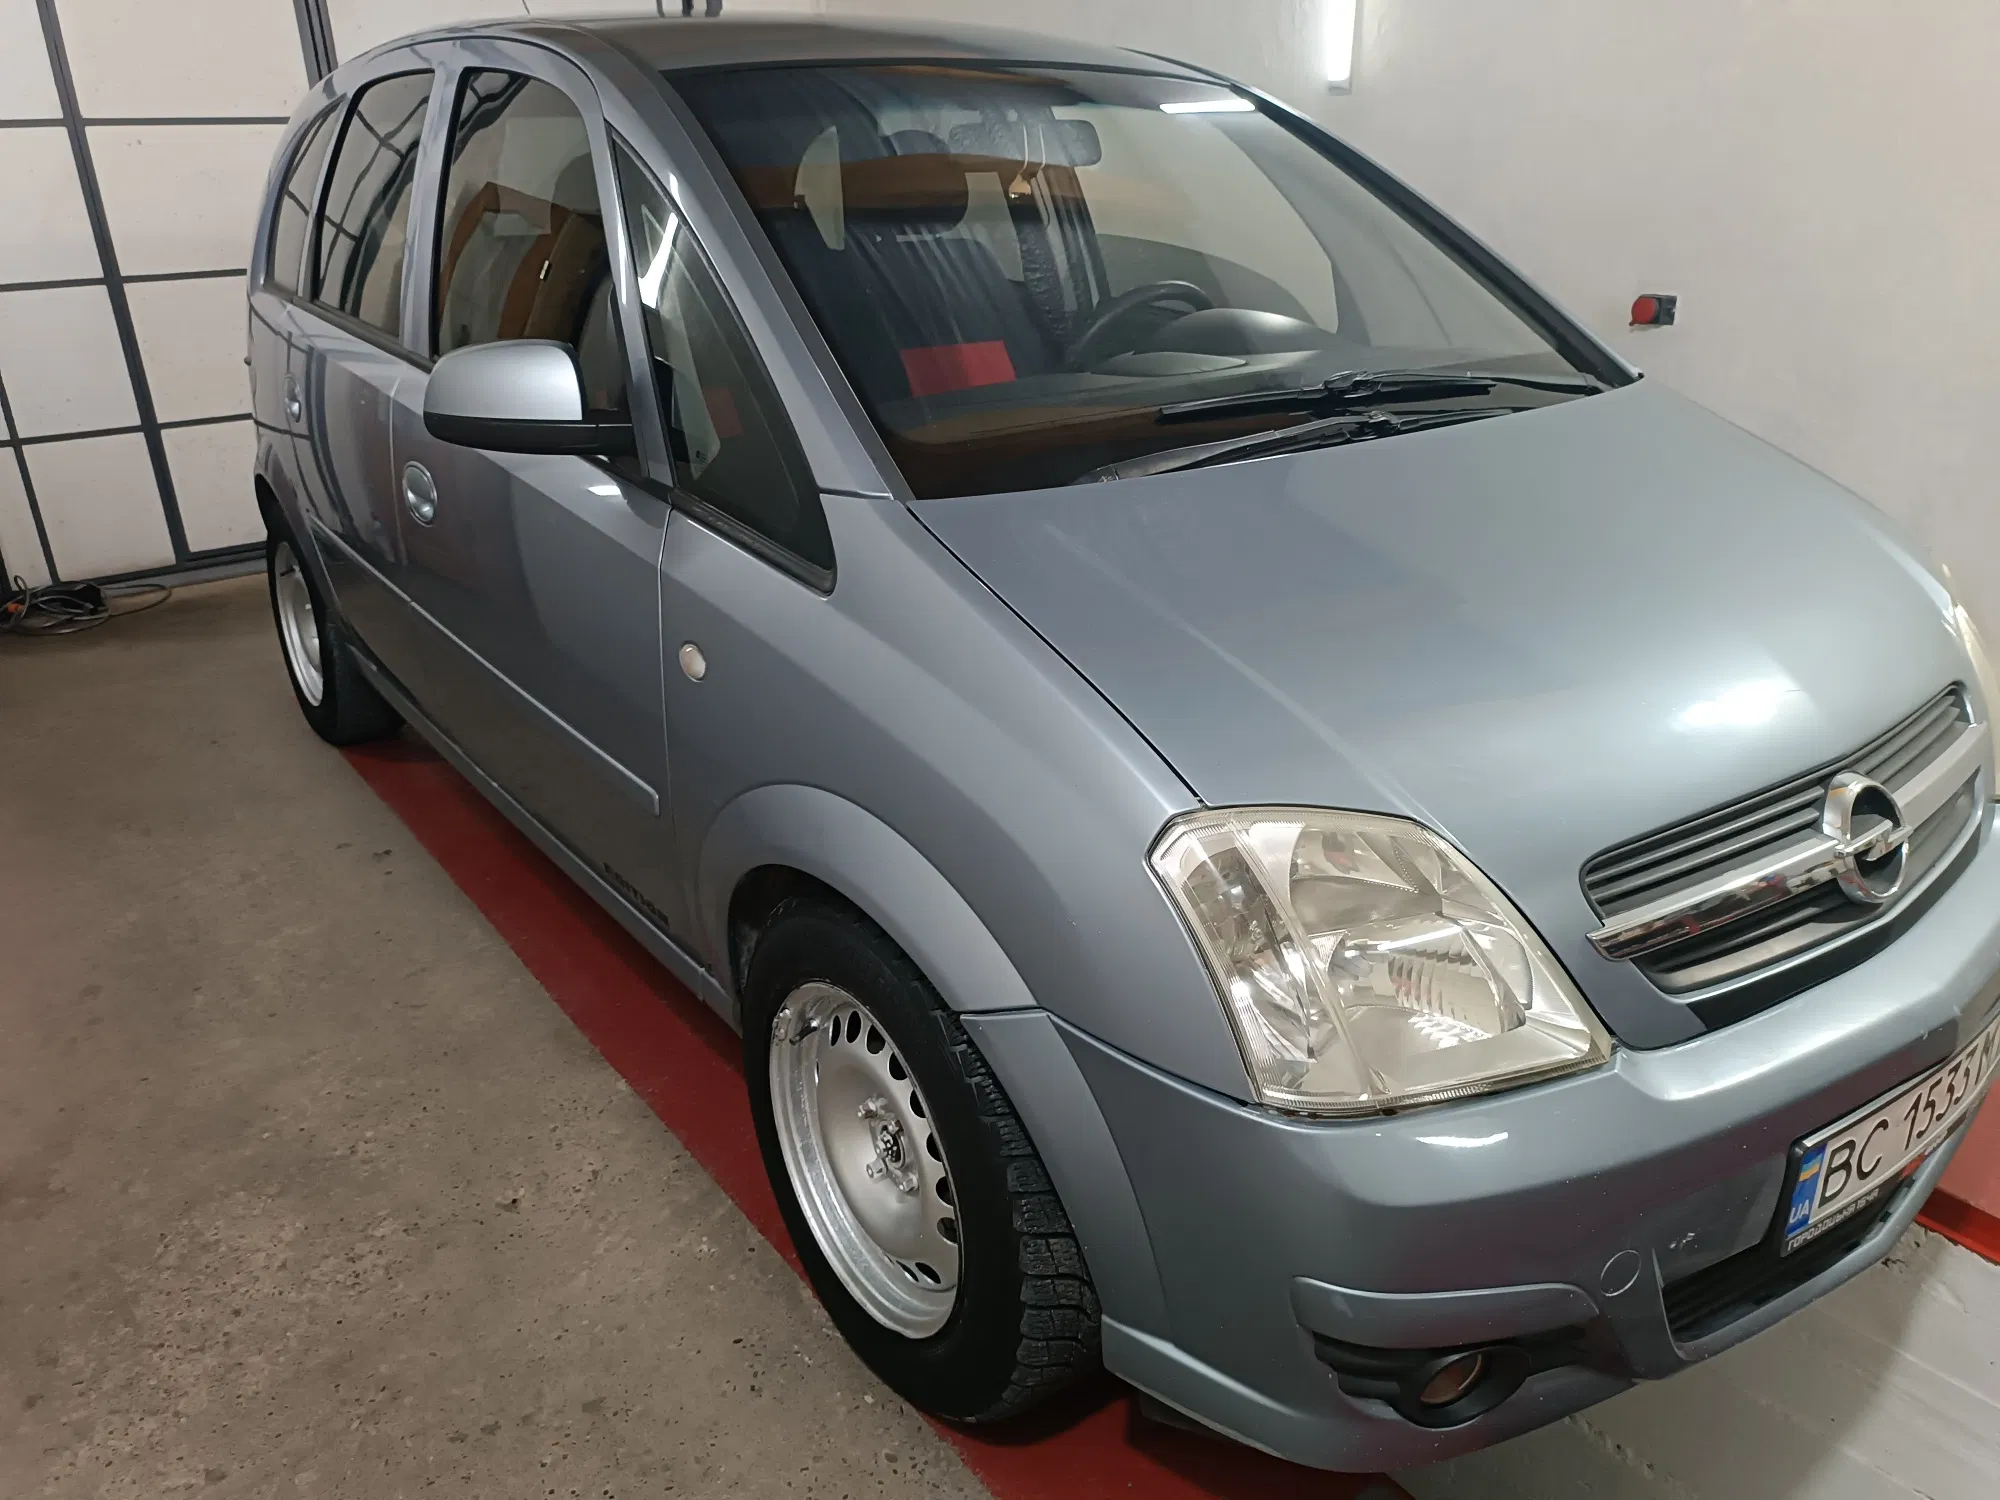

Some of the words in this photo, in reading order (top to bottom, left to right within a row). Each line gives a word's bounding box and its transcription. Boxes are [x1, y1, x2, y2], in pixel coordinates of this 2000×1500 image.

[1818, 1119, 1889, 1208] BC
[1903, 1043, 1979, 1151] 1533
[1789, 1199, 1809, 1224] UA
